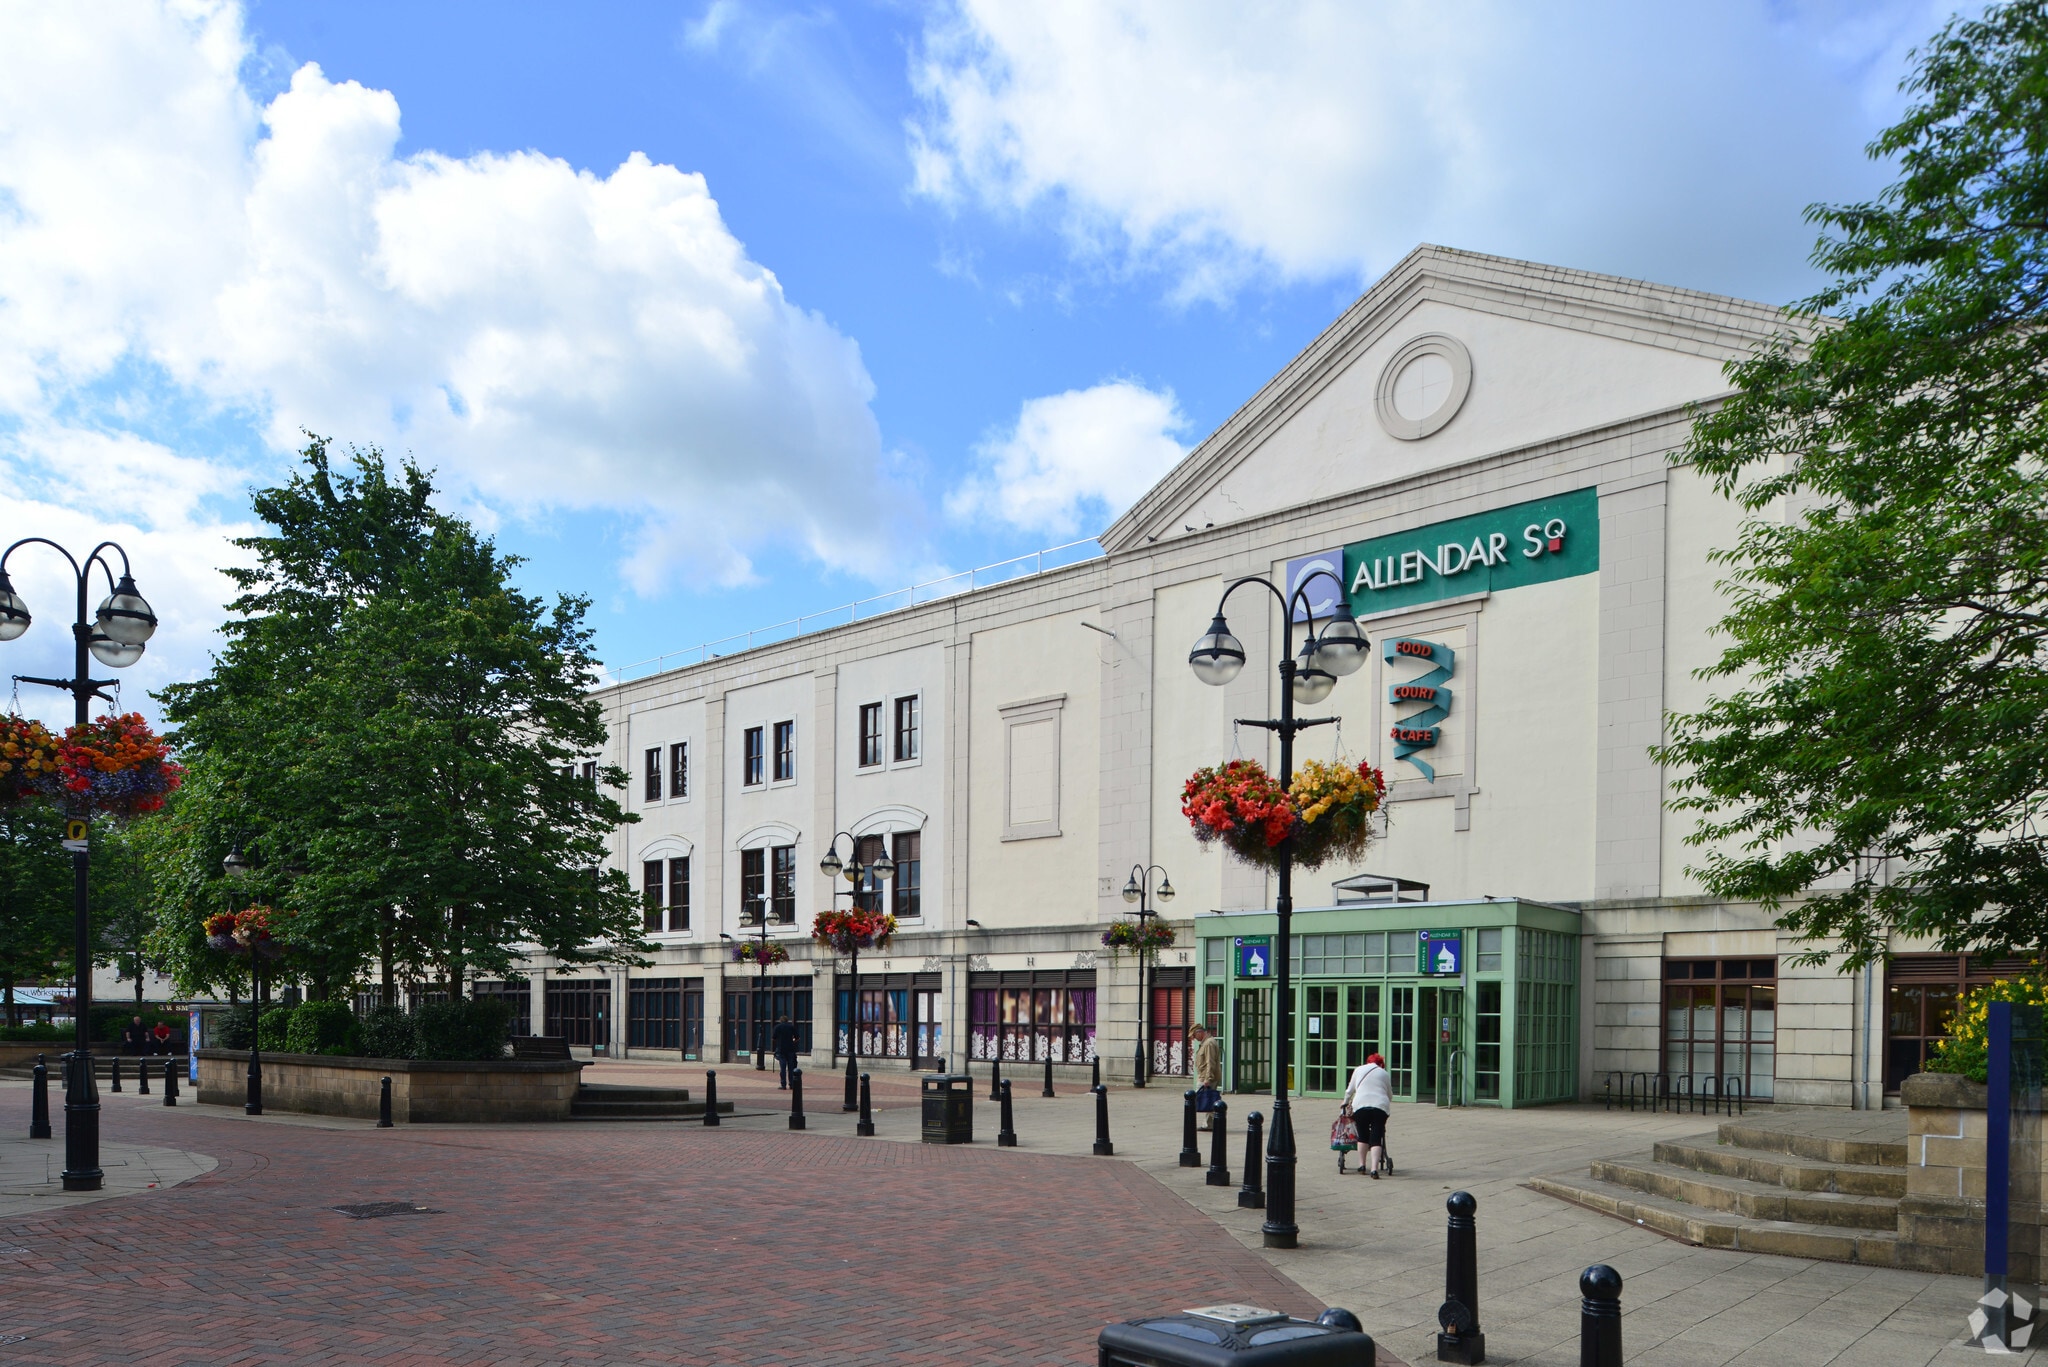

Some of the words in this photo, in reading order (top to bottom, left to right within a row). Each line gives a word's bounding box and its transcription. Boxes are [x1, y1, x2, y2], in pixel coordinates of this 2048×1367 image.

[1395, 641, 1432, 658] FOOD
[1393, 685, 1435, 700] COURT
[1399, 729, 1432, 741] CAFE
[1027, 956, 1034, 967] H
[1179, 951, 1187, 962] H
